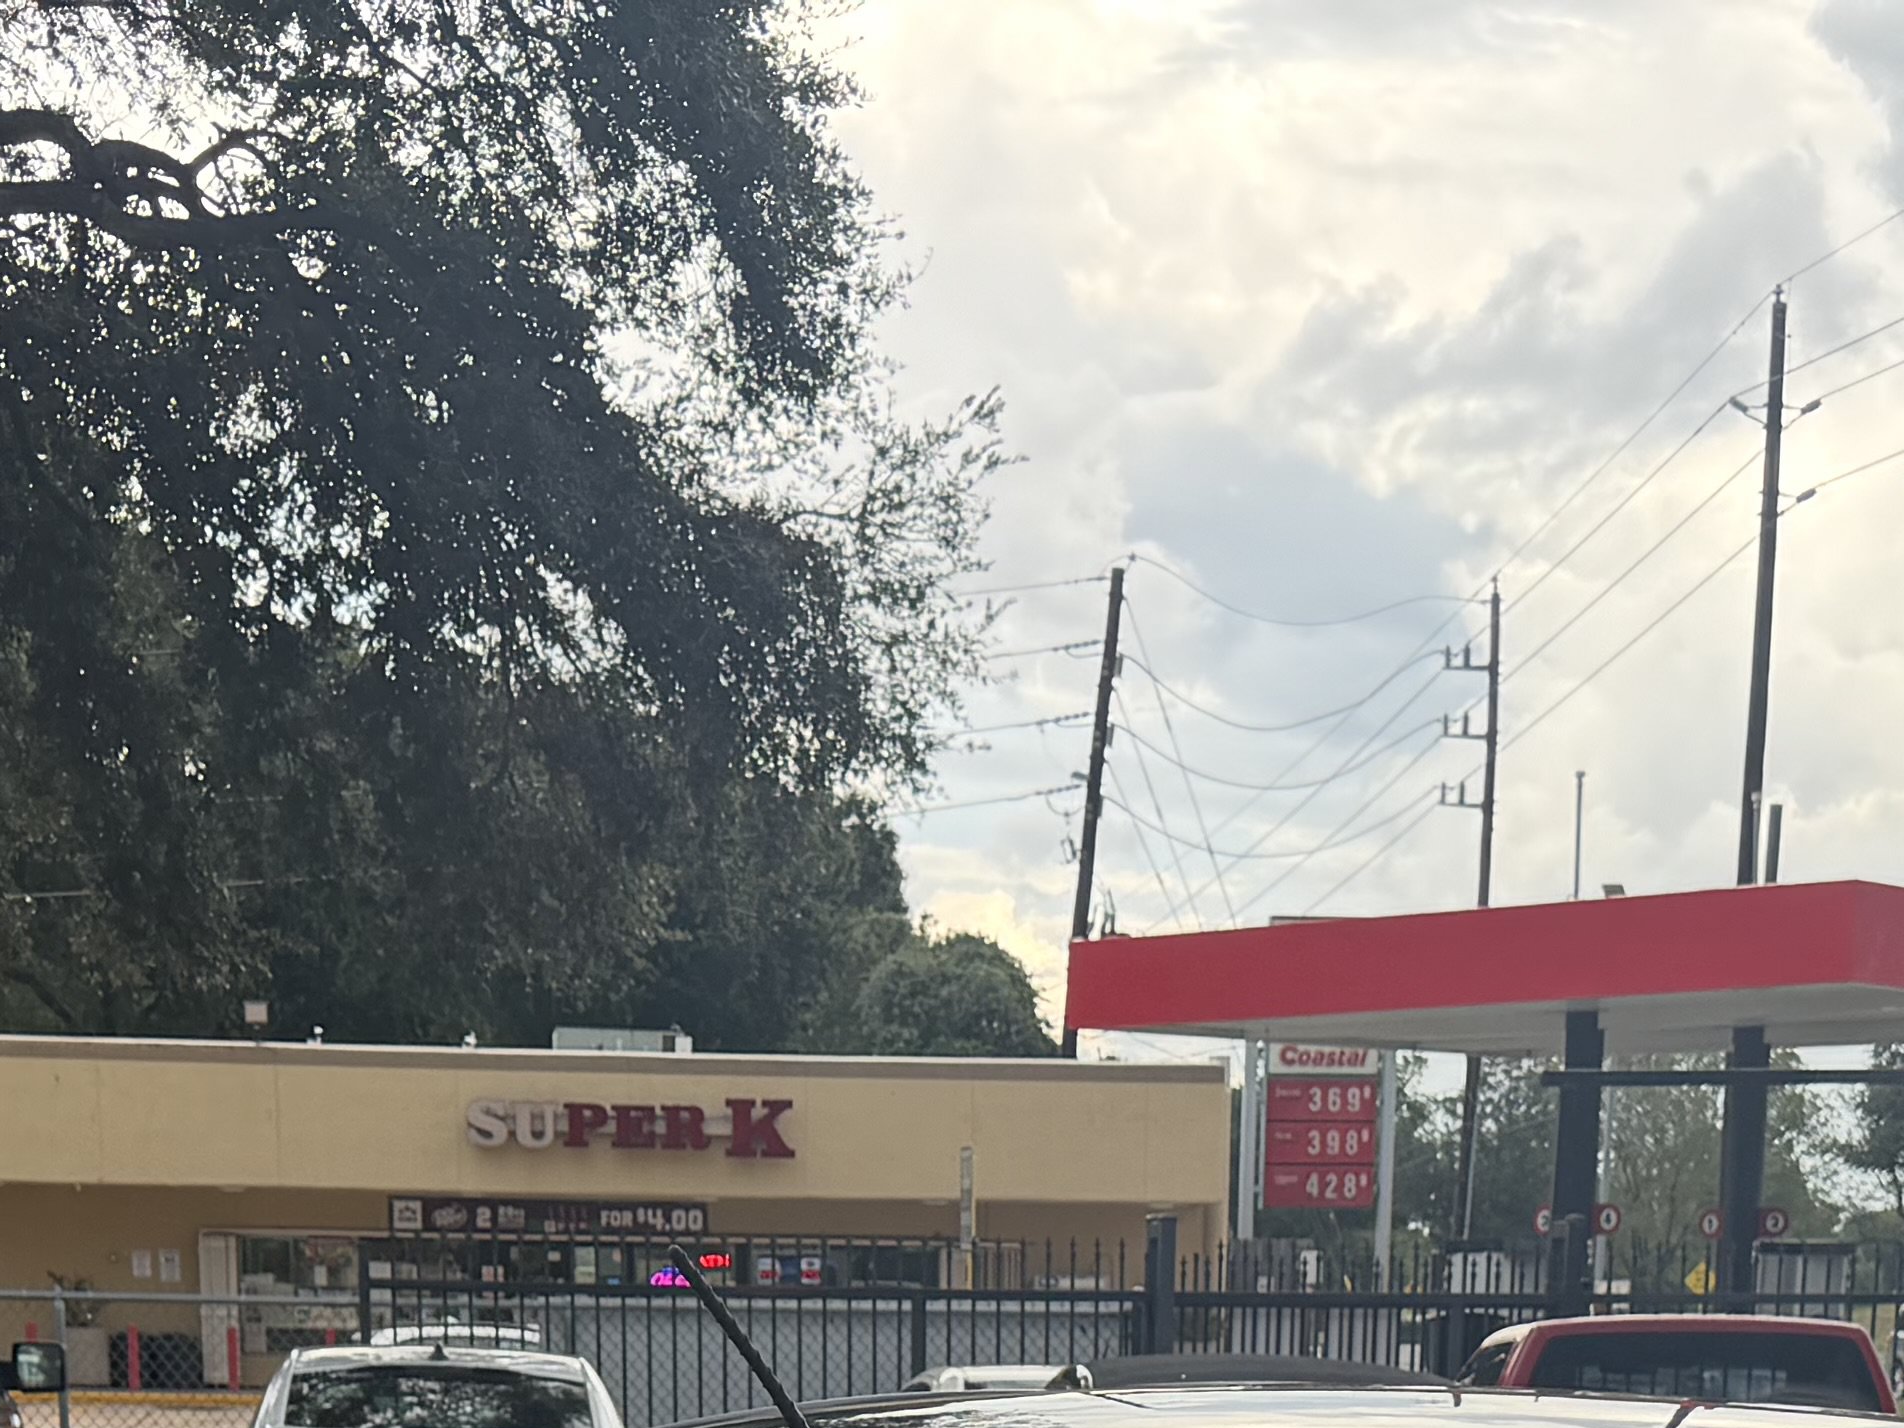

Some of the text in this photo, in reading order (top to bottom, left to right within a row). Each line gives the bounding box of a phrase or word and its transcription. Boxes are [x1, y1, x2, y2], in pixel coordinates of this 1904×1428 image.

[1279, 1044, 1368, 1067] Coastal
[467, 1098, 796, 1158] SUPER K
[476, 1206, 492, 1229] 2
[600, 1209, 633, 1228] FOR
[636, 1207, 704, 1231] $4.00
